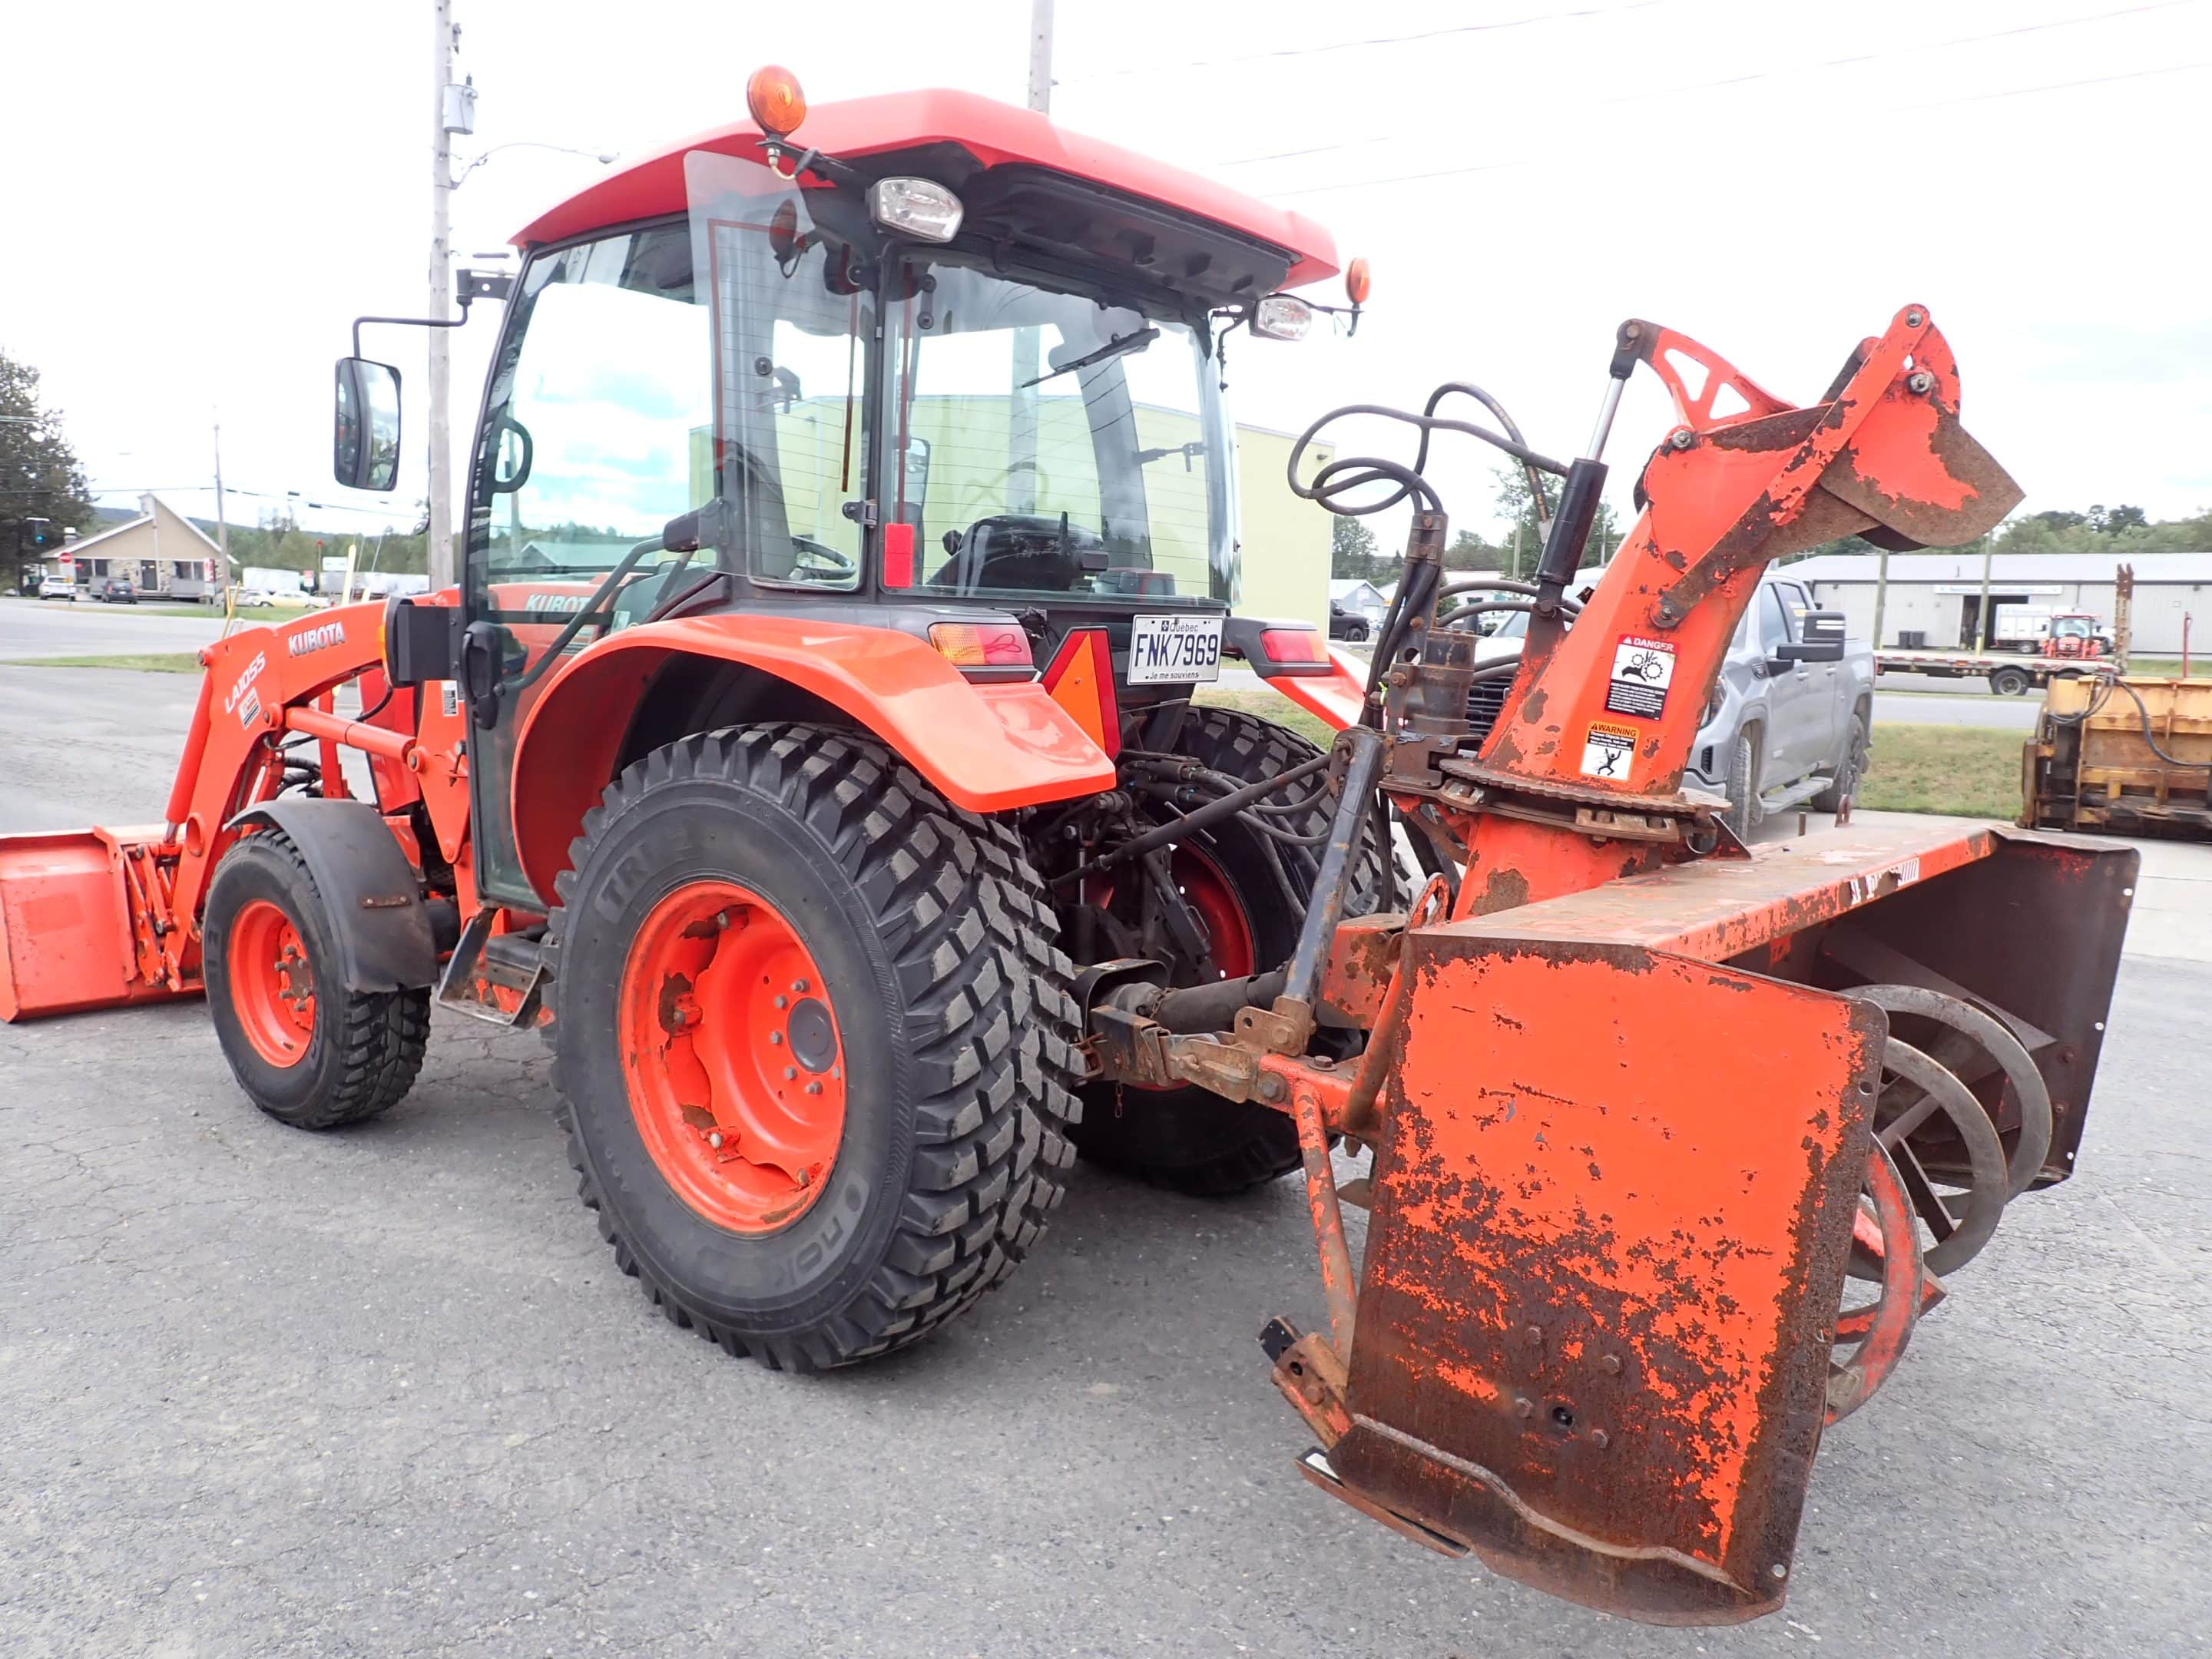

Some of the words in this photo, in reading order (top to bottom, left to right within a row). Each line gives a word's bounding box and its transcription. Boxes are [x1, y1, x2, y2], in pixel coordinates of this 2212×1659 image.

[525, 594, 591, 612] KUBOT
[288, 621, 345, 657] KUBOTA
[1633, 637, 1674, 652] DANGER
[1134, 634, 1219, 667] FNK7969
[1598, 723, 1637, 737] WARNING
